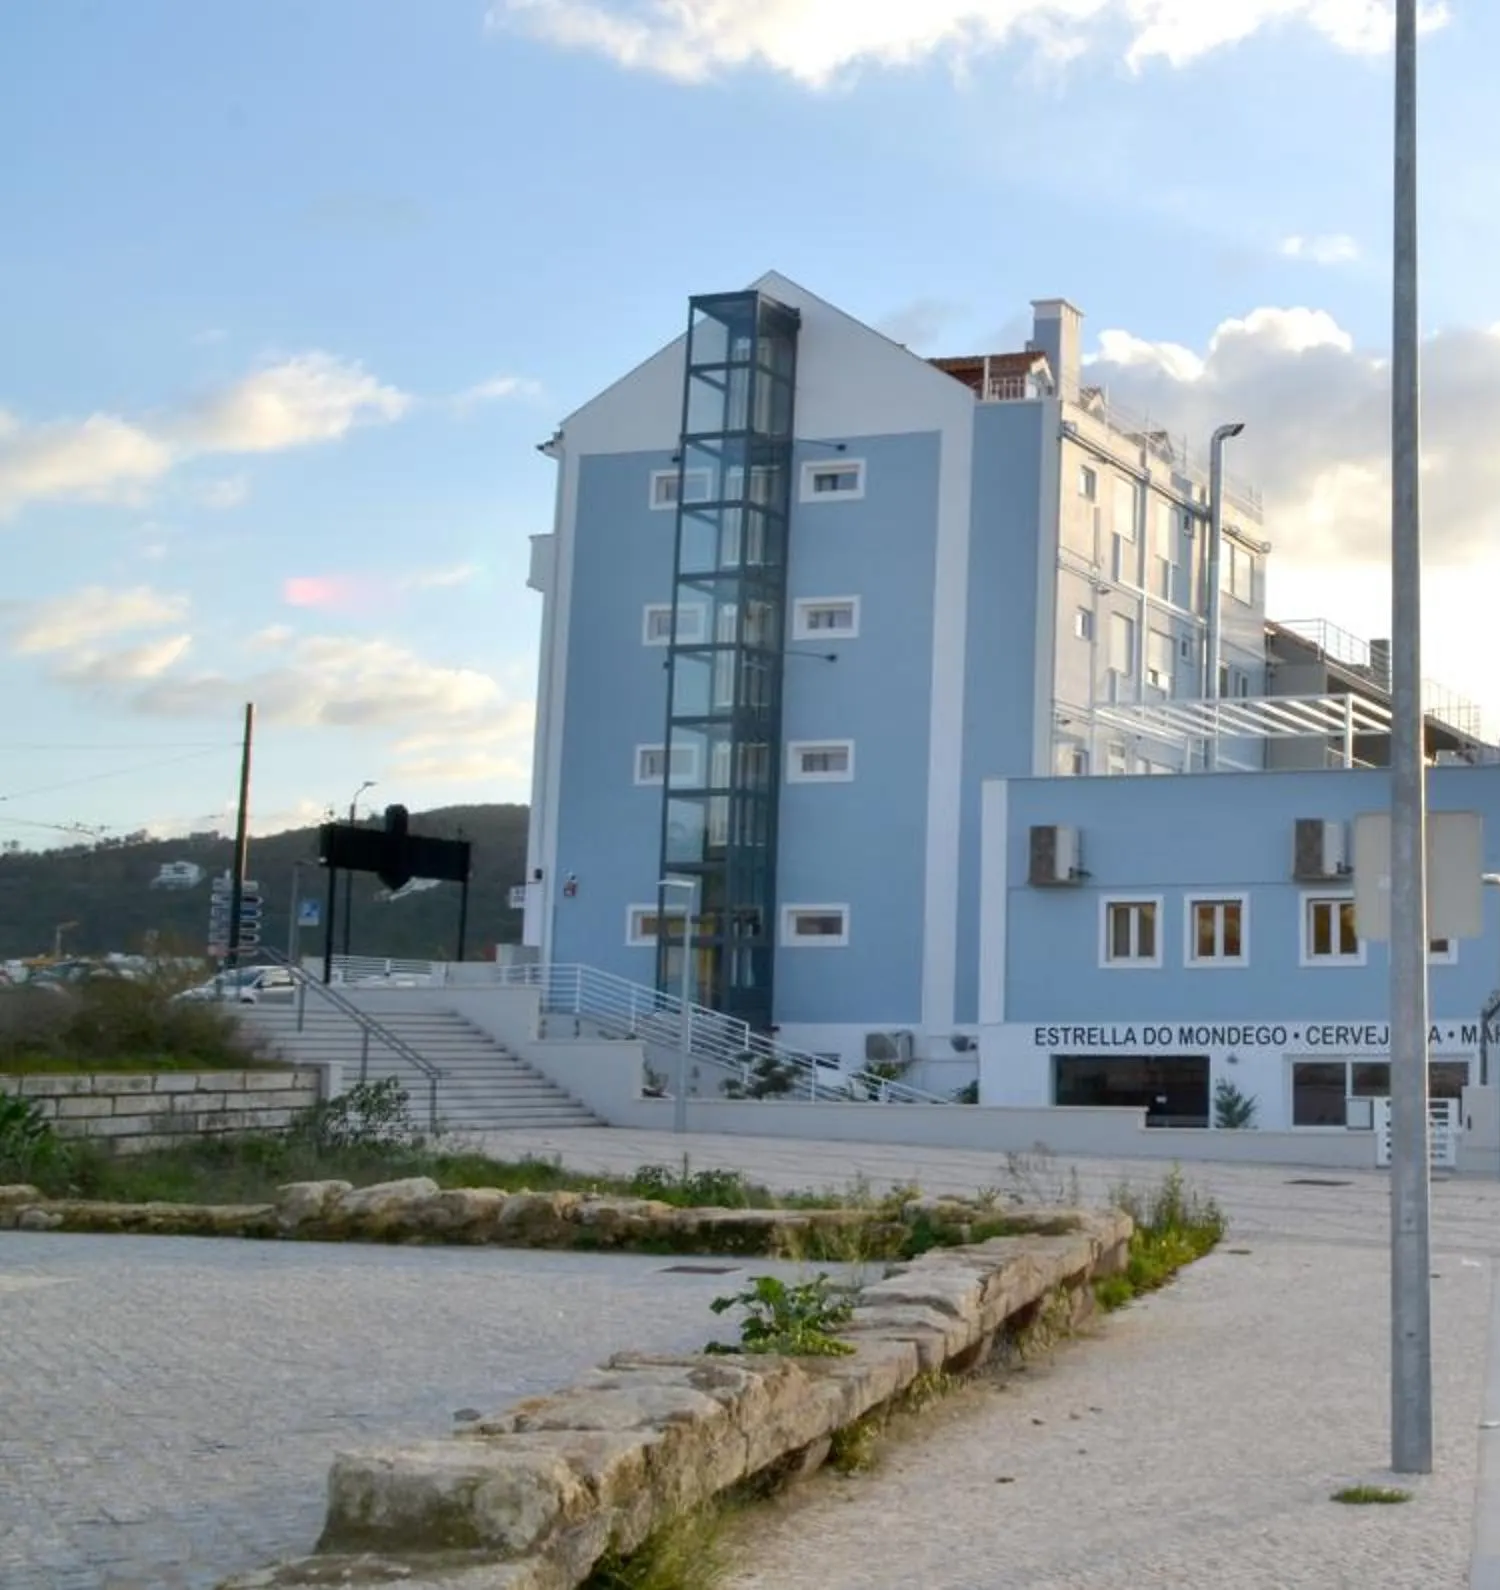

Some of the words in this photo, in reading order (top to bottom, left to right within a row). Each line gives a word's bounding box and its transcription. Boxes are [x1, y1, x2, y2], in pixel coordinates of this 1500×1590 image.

[1034, 1026, 1137, 1047] ESTRELLA
[1143, 1026, 1173, 1046] DO
[1179, 1025, 1288, 1046] MONDEGO
[1305, 1024, 1443, 1046] CERVEJA
